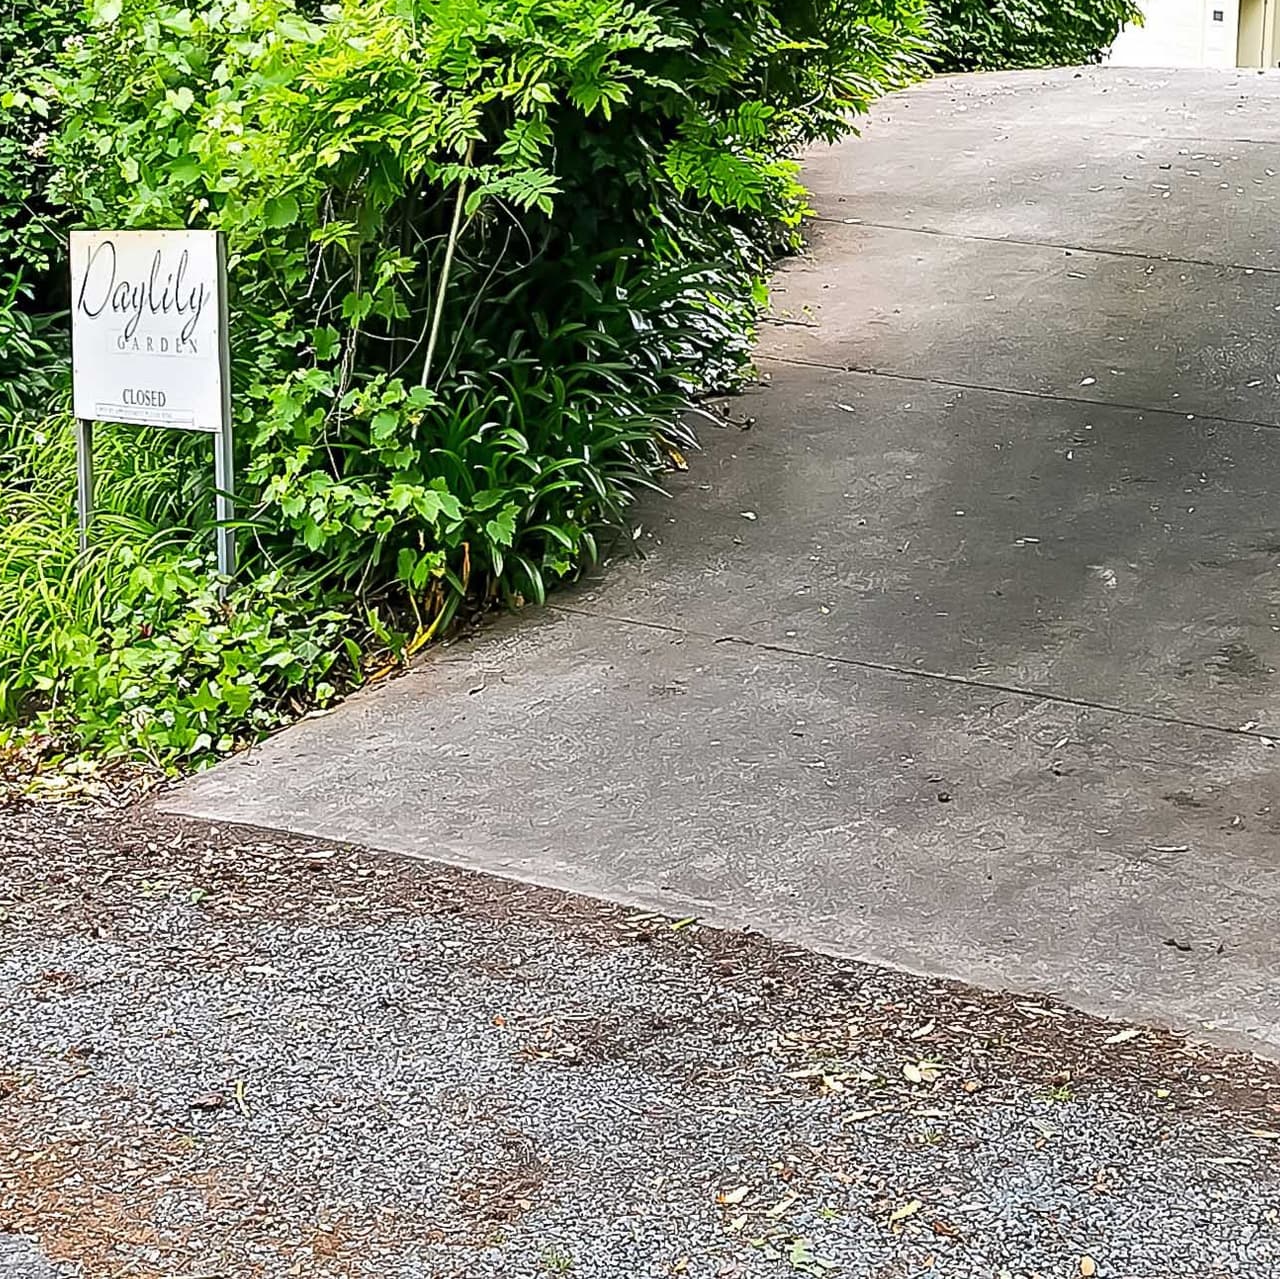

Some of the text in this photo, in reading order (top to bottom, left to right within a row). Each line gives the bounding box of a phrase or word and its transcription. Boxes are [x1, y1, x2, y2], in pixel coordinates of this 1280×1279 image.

[77, 240, 210, 343] Daylily
[117, 335, 198, 354] GARDEN
[122, 388, 166, 408] CLOSED
